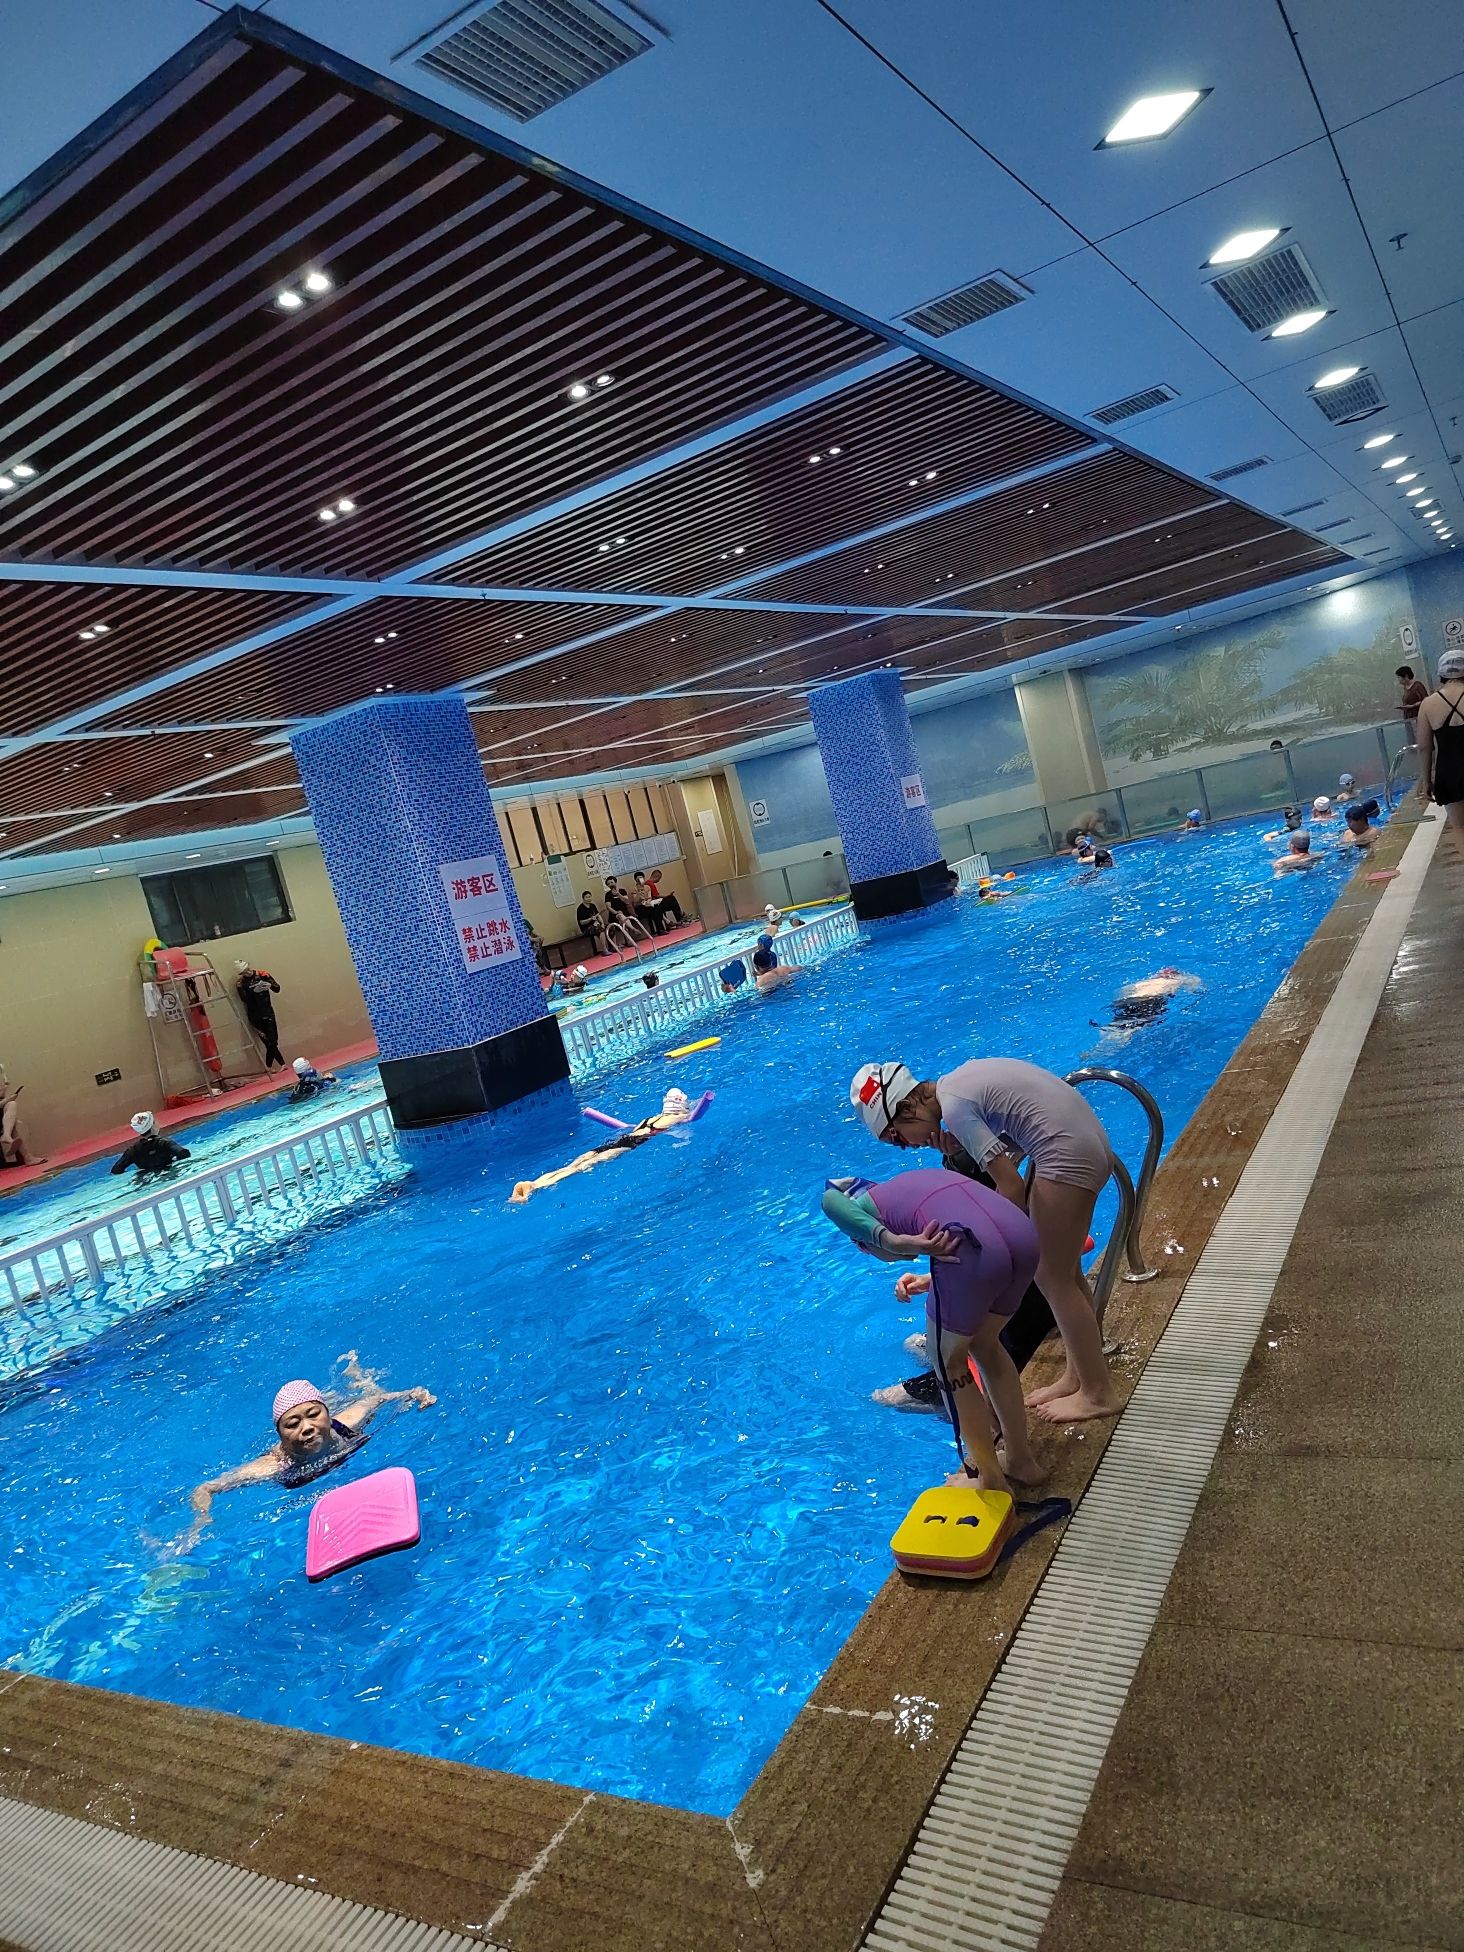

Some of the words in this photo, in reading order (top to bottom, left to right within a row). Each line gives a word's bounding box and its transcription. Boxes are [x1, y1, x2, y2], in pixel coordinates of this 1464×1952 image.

[451, 873, 498, 900] 游客区
[462, 918, 510, 943] 禁止跳水
[466, 936, 515, 962] 禁止潜泳
[869, 1092, 882, 1109] CHIN
